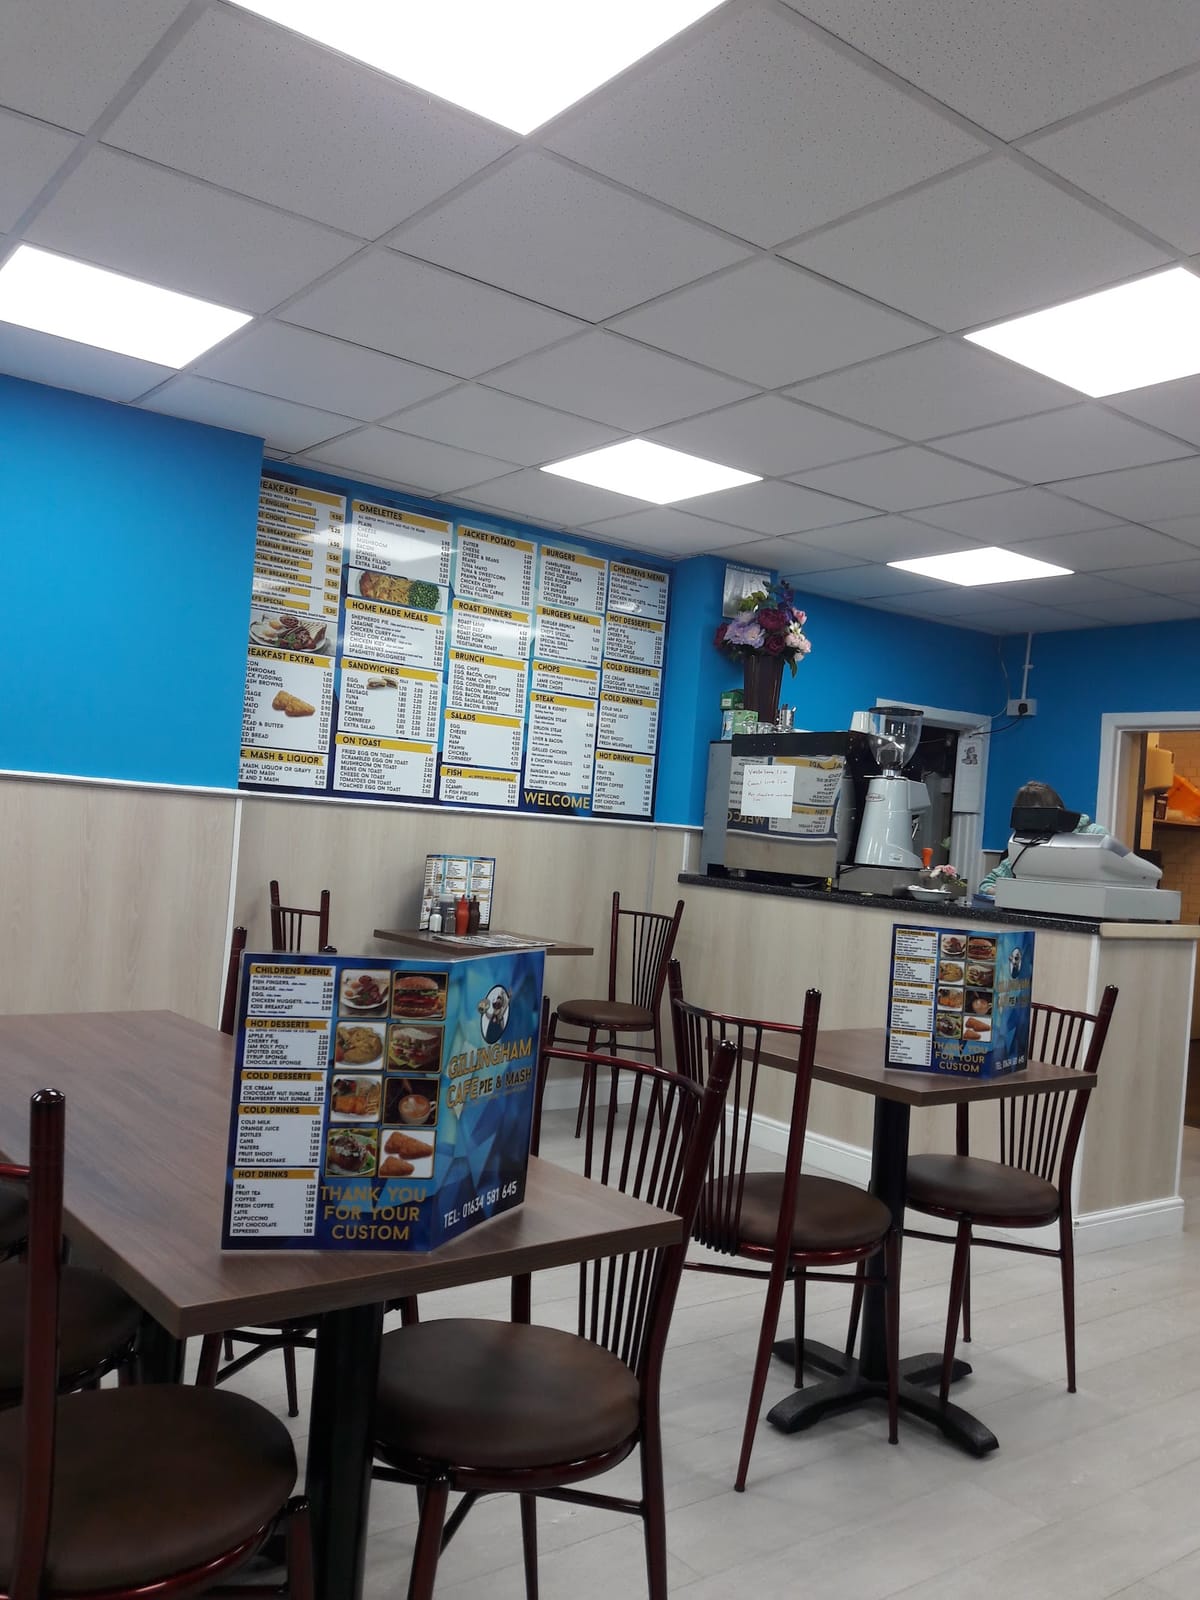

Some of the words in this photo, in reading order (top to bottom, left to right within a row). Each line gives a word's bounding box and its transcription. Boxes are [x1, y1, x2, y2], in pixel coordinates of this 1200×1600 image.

[261, 480, 297, 495] EAKFAST
[359, 504, 402, 520] OMELETTES
[463, 529, 488, 540] JACKET
[490, 535, 515, 547] POTATO
[546, 548, 575, 561] BURGERS
[613, 564, 645, 578] CHILDRENS
[647, 572, 664, 582] MENU
[352, 601, 376, 611] HOME
[379, 607, 401, 616] MADE
[404, 612, 428, 621] MEALS
[458, 602, 480, 611] ROAST
[483, 607, 512, 618] DINNERS
[542, 607, 570, 619] BURGERS
[573, 613, 589, 623] MEAL
[609, 614, 622, 622] HOT
[623, 617, 650, 628] DESSERTS
[289, 654, 314, 664] EXTRA
[455, 652, 484, 663] BRUNCH
[348, 660, 399, 674] SANDWICHES
[537, 663, 560, 672] CHOPS
[606, 662, 622, 671] COLD
[624, 665, 650, 675] DESSERTS
[535, 694, 554, 702] STEAK
[603, 693, 620, 701] COLD
[621, 696, 642, 705] DRINKS
[450, 711, 475, 721] SALADS
[342, 736, 355, 744] ON
[358, 738, 380, 746] TOAST
[250, 751, 274, 759] MASH
[286, 754, 319, 763] LIQUOR
[613, 754, 634, 762] DRINKS
[446, 768, 462, 776] FISH
[524, 791, 590, 809] WELCOME
[255, 966, 300, 974] CHILDRENS
[933, 1041, 964, 1052] THANK
[449, 1037, 533, 1078] GILLINGHAM
[935, 1051, 956, 1061] FOR
[959, 1053, 985, 1064] YOUR
[939, 1062, 979, 1072] CUSTOM
[446, 1078, 480, 1108] CAFE
[479, 1076, 492, 1096] PIE
[495, 1074, 502, 1089] &
[505, 1066, 531, 1086] MASH
[320, 1186, 381, 1201] THANK
[386, 1187, 426, 1202] YOU
[443, 1210, 460, 1228] TEL:
[462, 1197, 484, 1218] 01634
[486, 1189, 499, 1205] 581
[502, 1181, 517, 1199] 645
[324, 1204, 361, 1220] FOR
[370, 1206, 419, 1220] YOUR
[331, 1224, 408, 1240] CUSTOM
